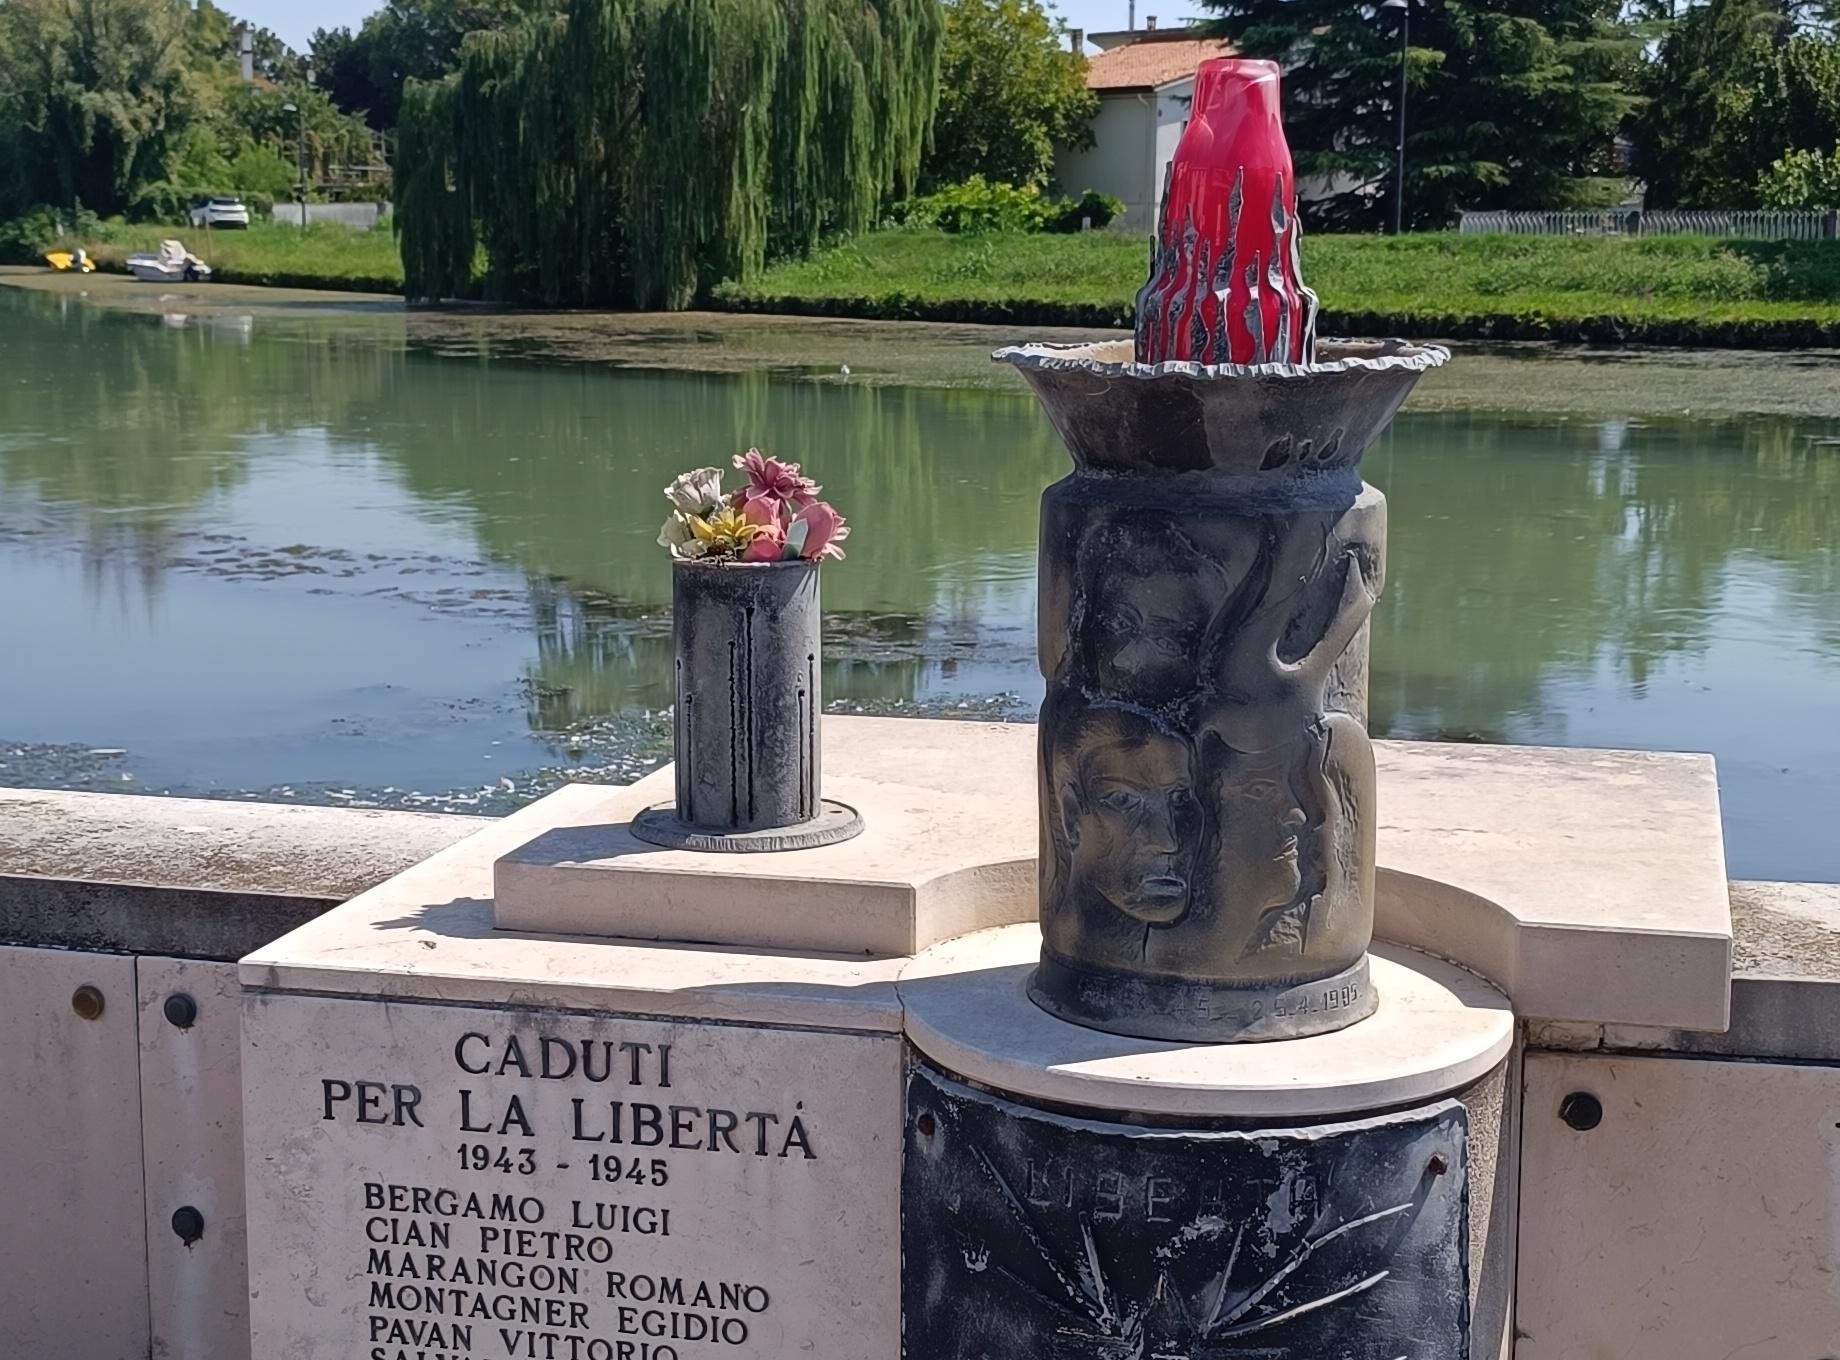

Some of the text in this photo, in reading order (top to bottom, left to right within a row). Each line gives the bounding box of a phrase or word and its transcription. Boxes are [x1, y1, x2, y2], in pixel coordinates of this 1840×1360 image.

[455, 1032, 672, 1087] CADUTI
[321, 1079, 424, 1127] PER
[459, 1090, 535, 1137] LA
[457, 1143, 536, 1175] 1943
[589, 1154, 669, 1186] 1945
[364, 1183, 670, 1236] BERGAMO LUIGI
[366, 1217, 613, 1263] CIAN PIETRO
[366, 1248, 770, 1312] MARANGON ROMANO
[368, 1281, 748, 1345] MONTAGNER EGIDIO
[369, 1316, 472, 1351] PAVAN
